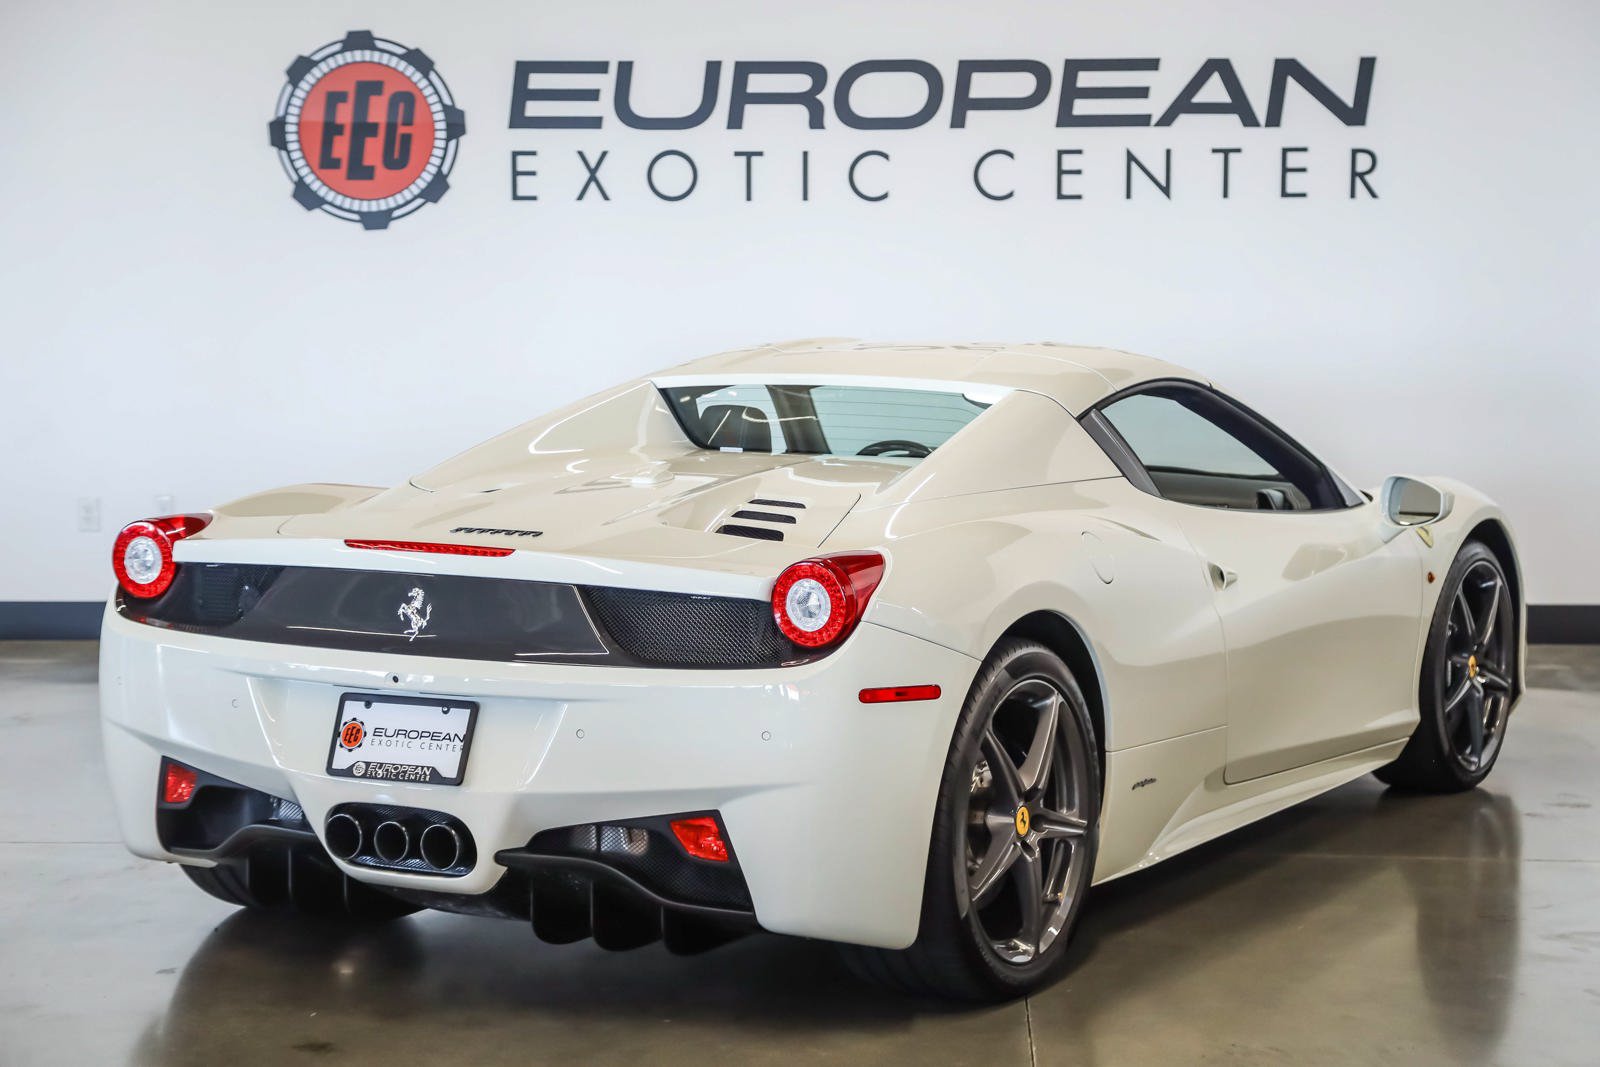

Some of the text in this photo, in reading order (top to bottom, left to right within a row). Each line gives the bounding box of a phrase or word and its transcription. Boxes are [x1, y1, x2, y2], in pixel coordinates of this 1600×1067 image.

[508, 56, 1377, 130] EUROPEAN
[318, 80, 416, 181] EEC
[511, 147, 1379, 202] EXOTIC CENTER
[344, 726, 361, 744] EEC
[370, 738, 412, 749] EXOTIC
[372, 727, 466, 743] EUROPEAN
[366, 770, 431, 782] EXOTIC CENTER
[367, 762, 432, 775] EUROPEAN
